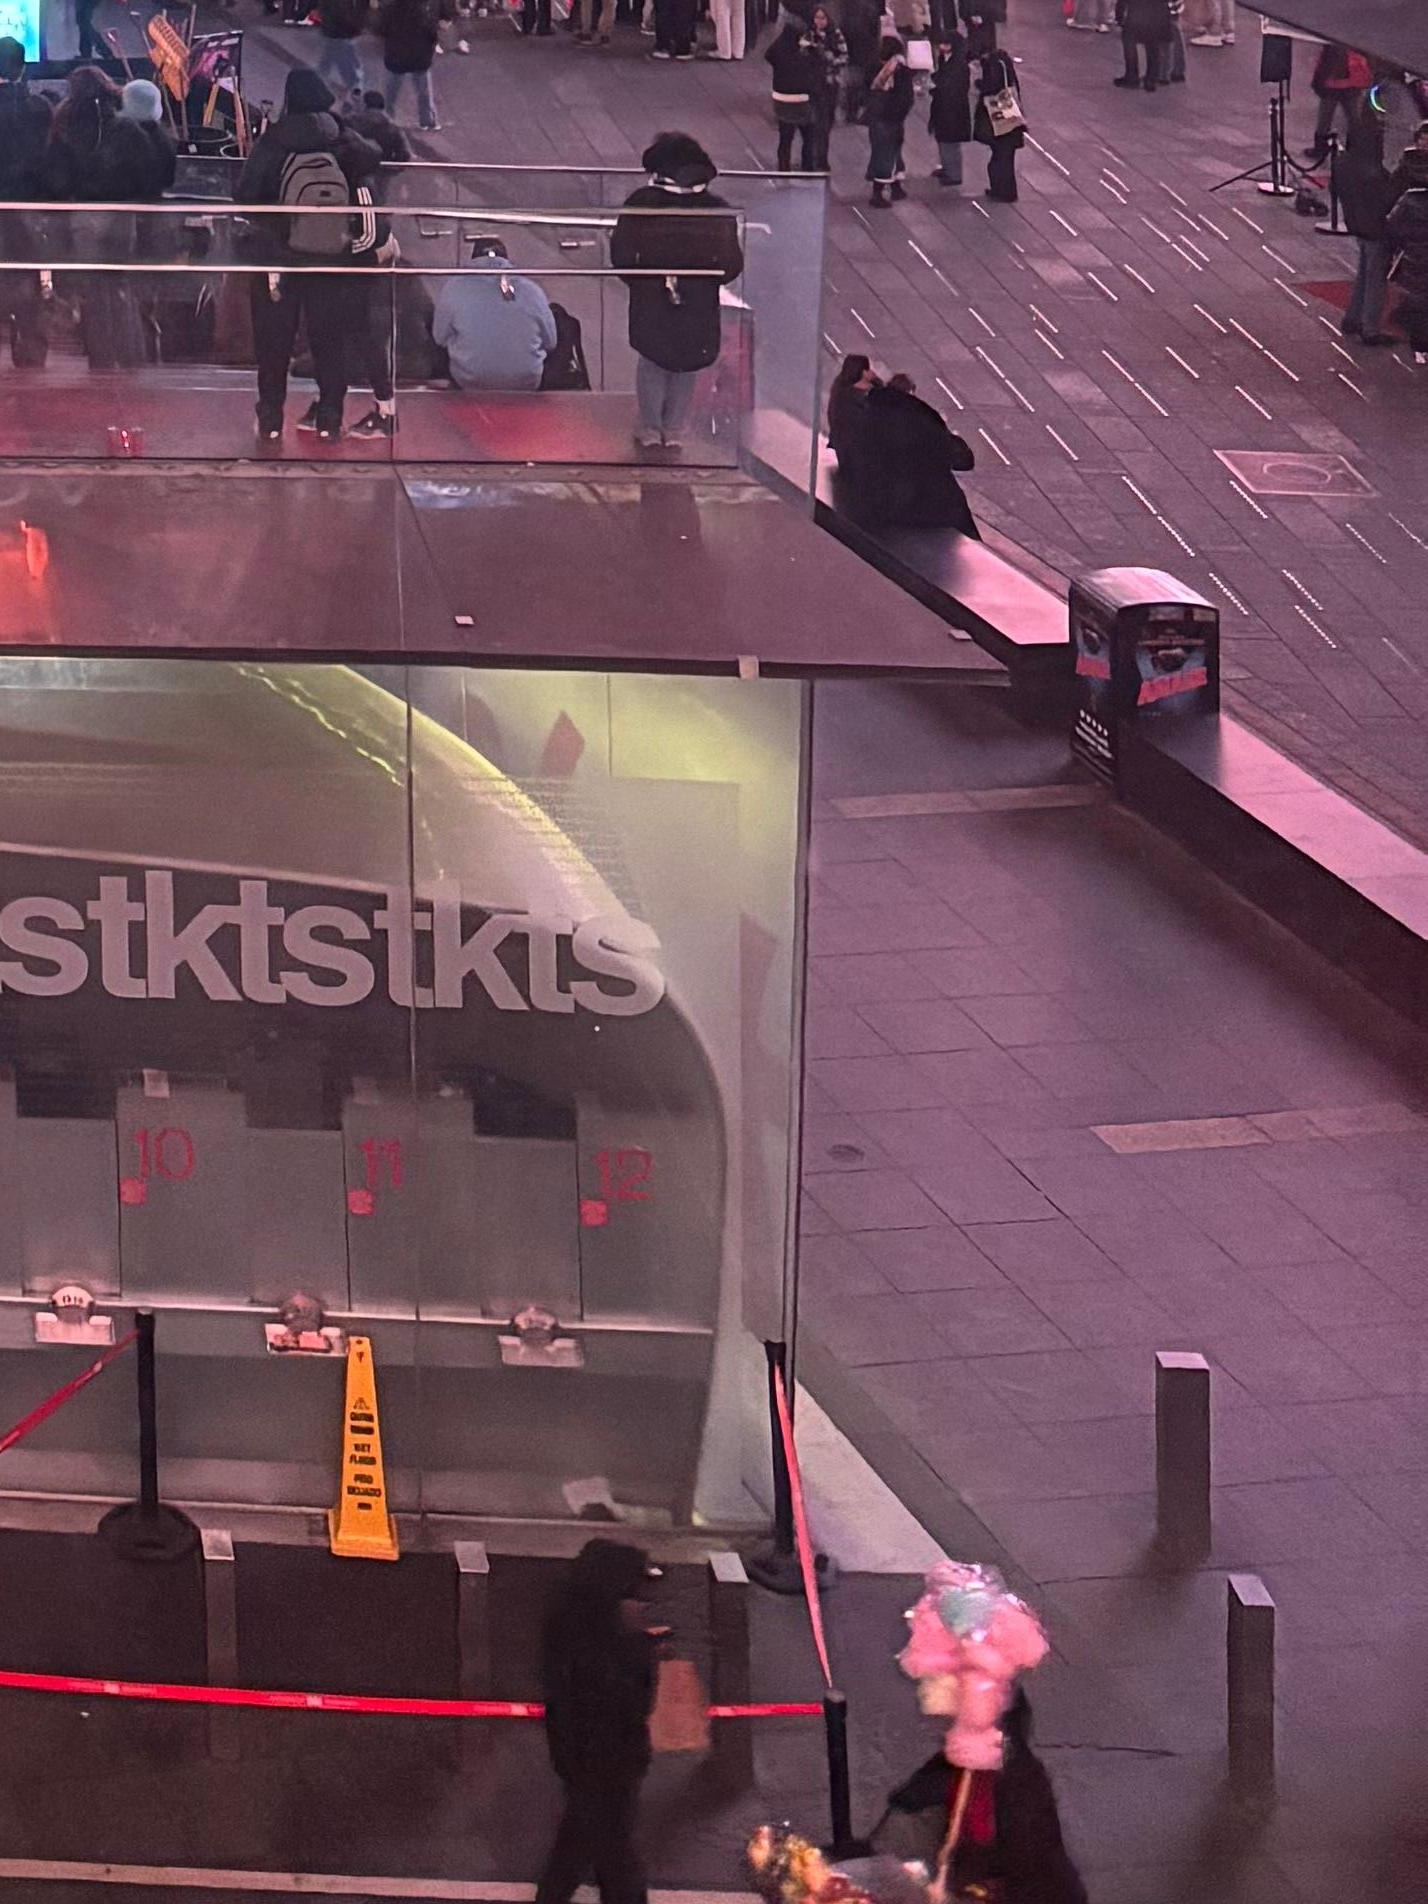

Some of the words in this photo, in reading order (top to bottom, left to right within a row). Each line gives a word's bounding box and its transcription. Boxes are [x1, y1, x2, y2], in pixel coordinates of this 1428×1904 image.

[133, 1127, 194, 1181] 10
[362, 1138, 405, 1189] 11
[593, 1148, 652, 1201] 12
